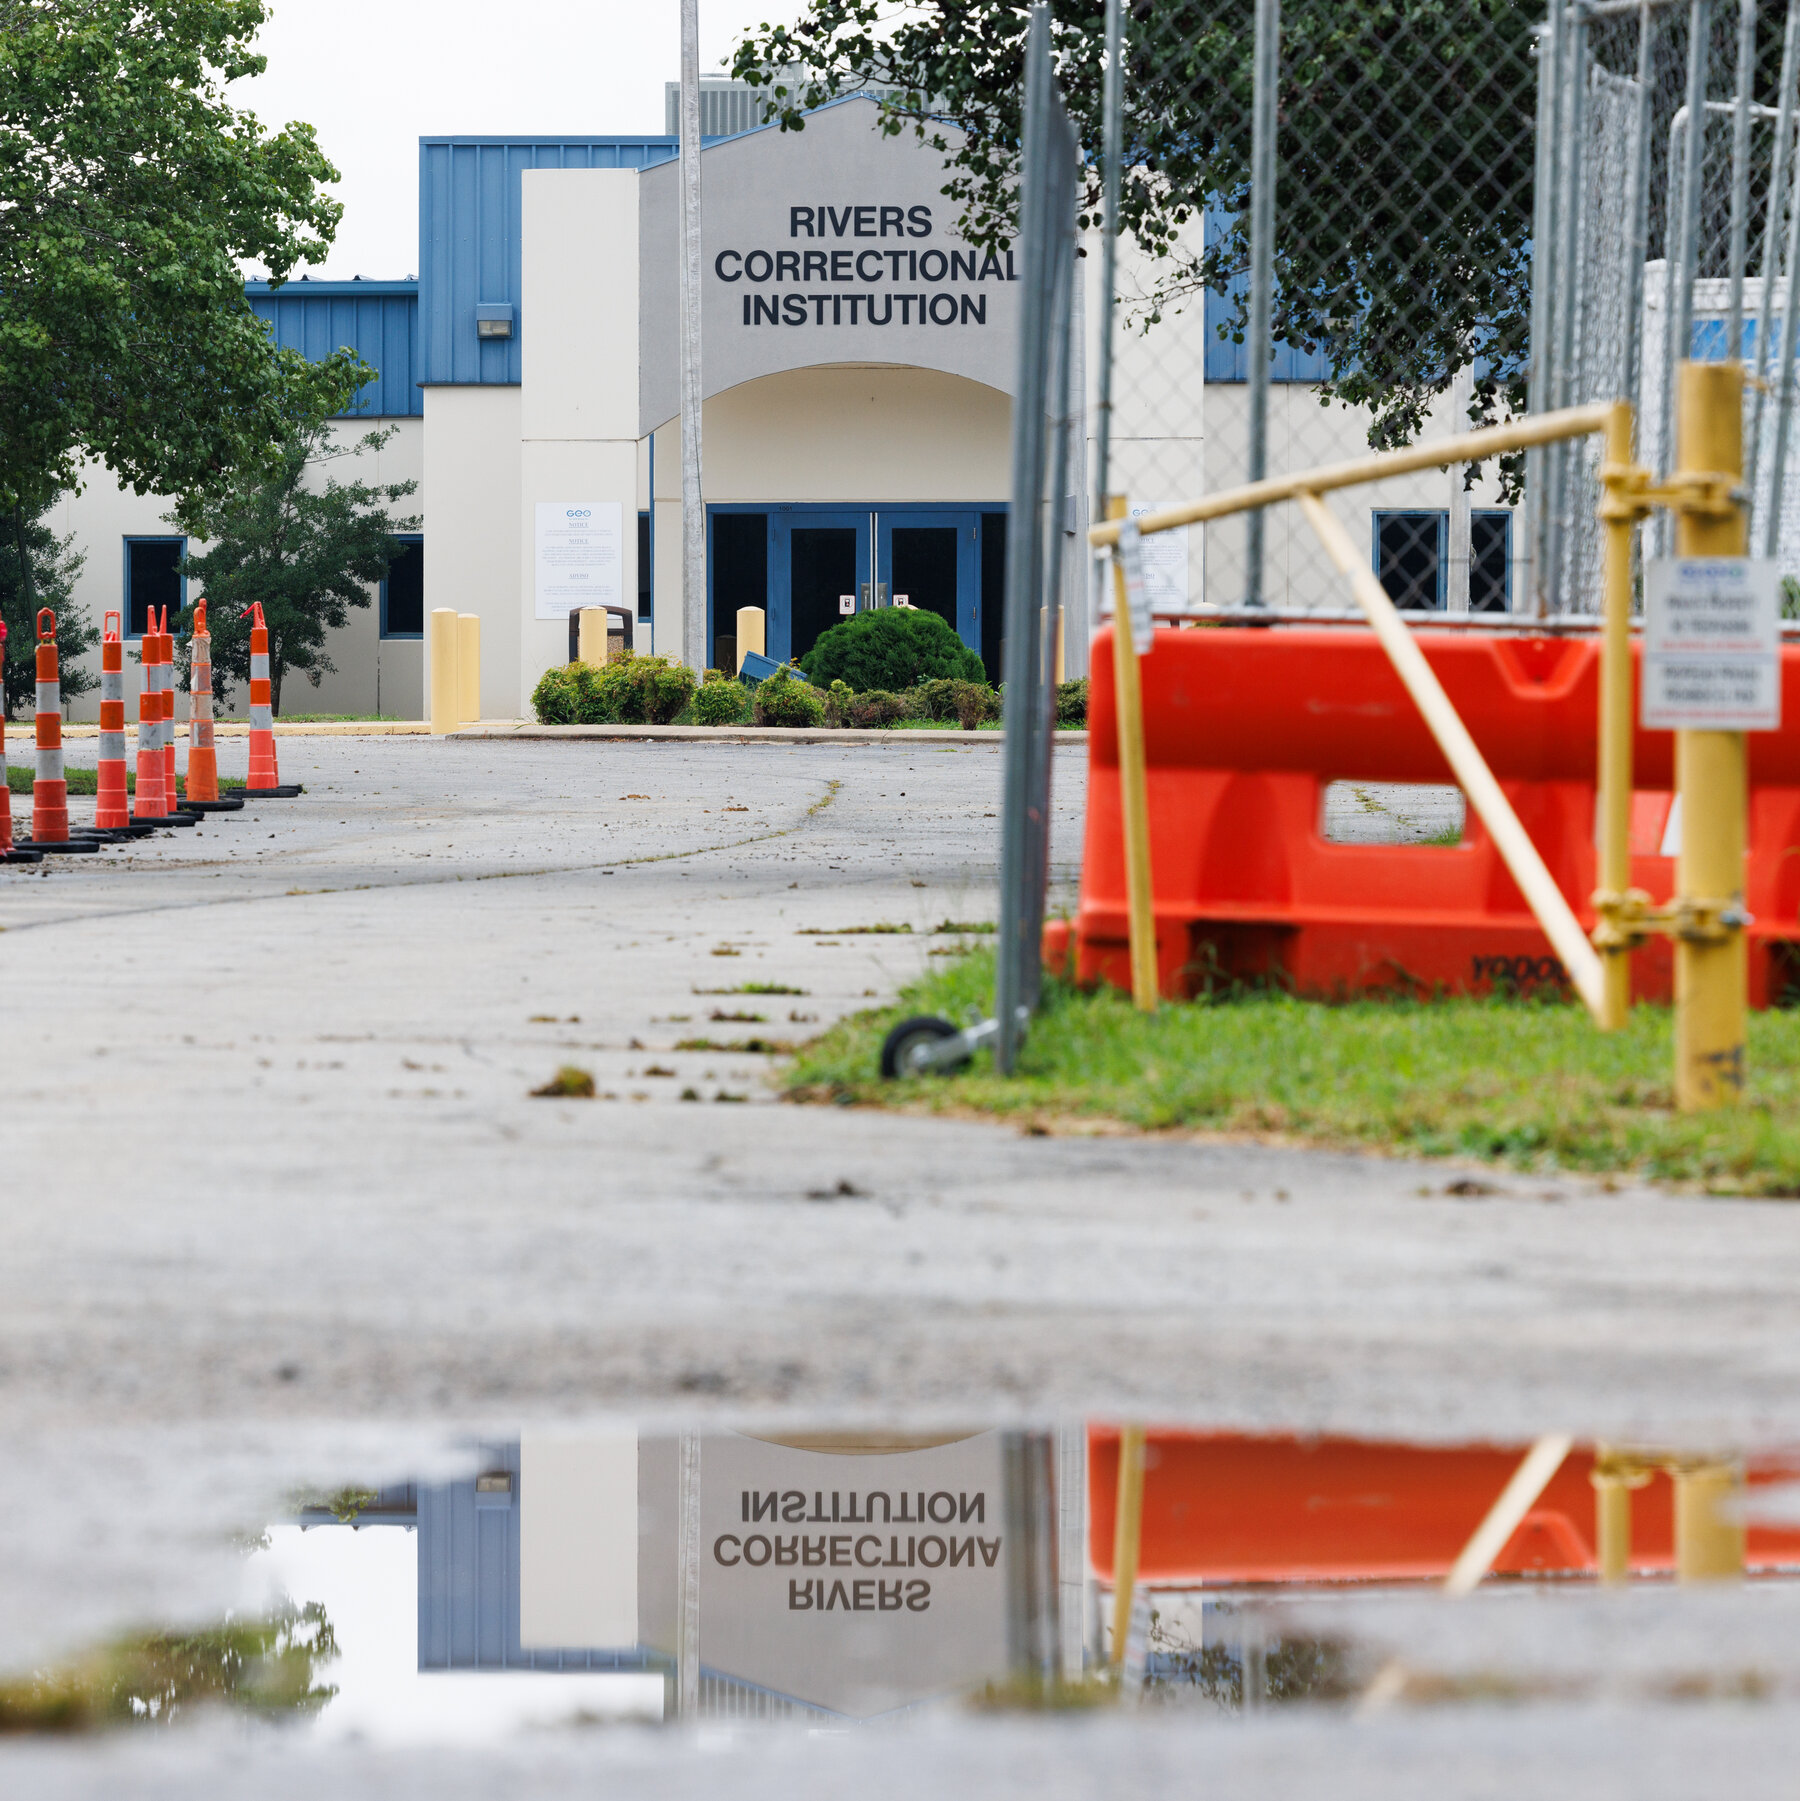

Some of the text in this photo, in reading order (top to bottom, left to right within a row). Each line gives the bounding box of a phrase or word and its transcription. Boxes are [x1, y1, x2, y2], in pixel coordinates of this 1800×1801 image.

[790, 205, 933, 238] RIVERS
[714, 249, 1024, 282] CORRECTIONAL
[743, 293, 987, 326] INSTITUTION
